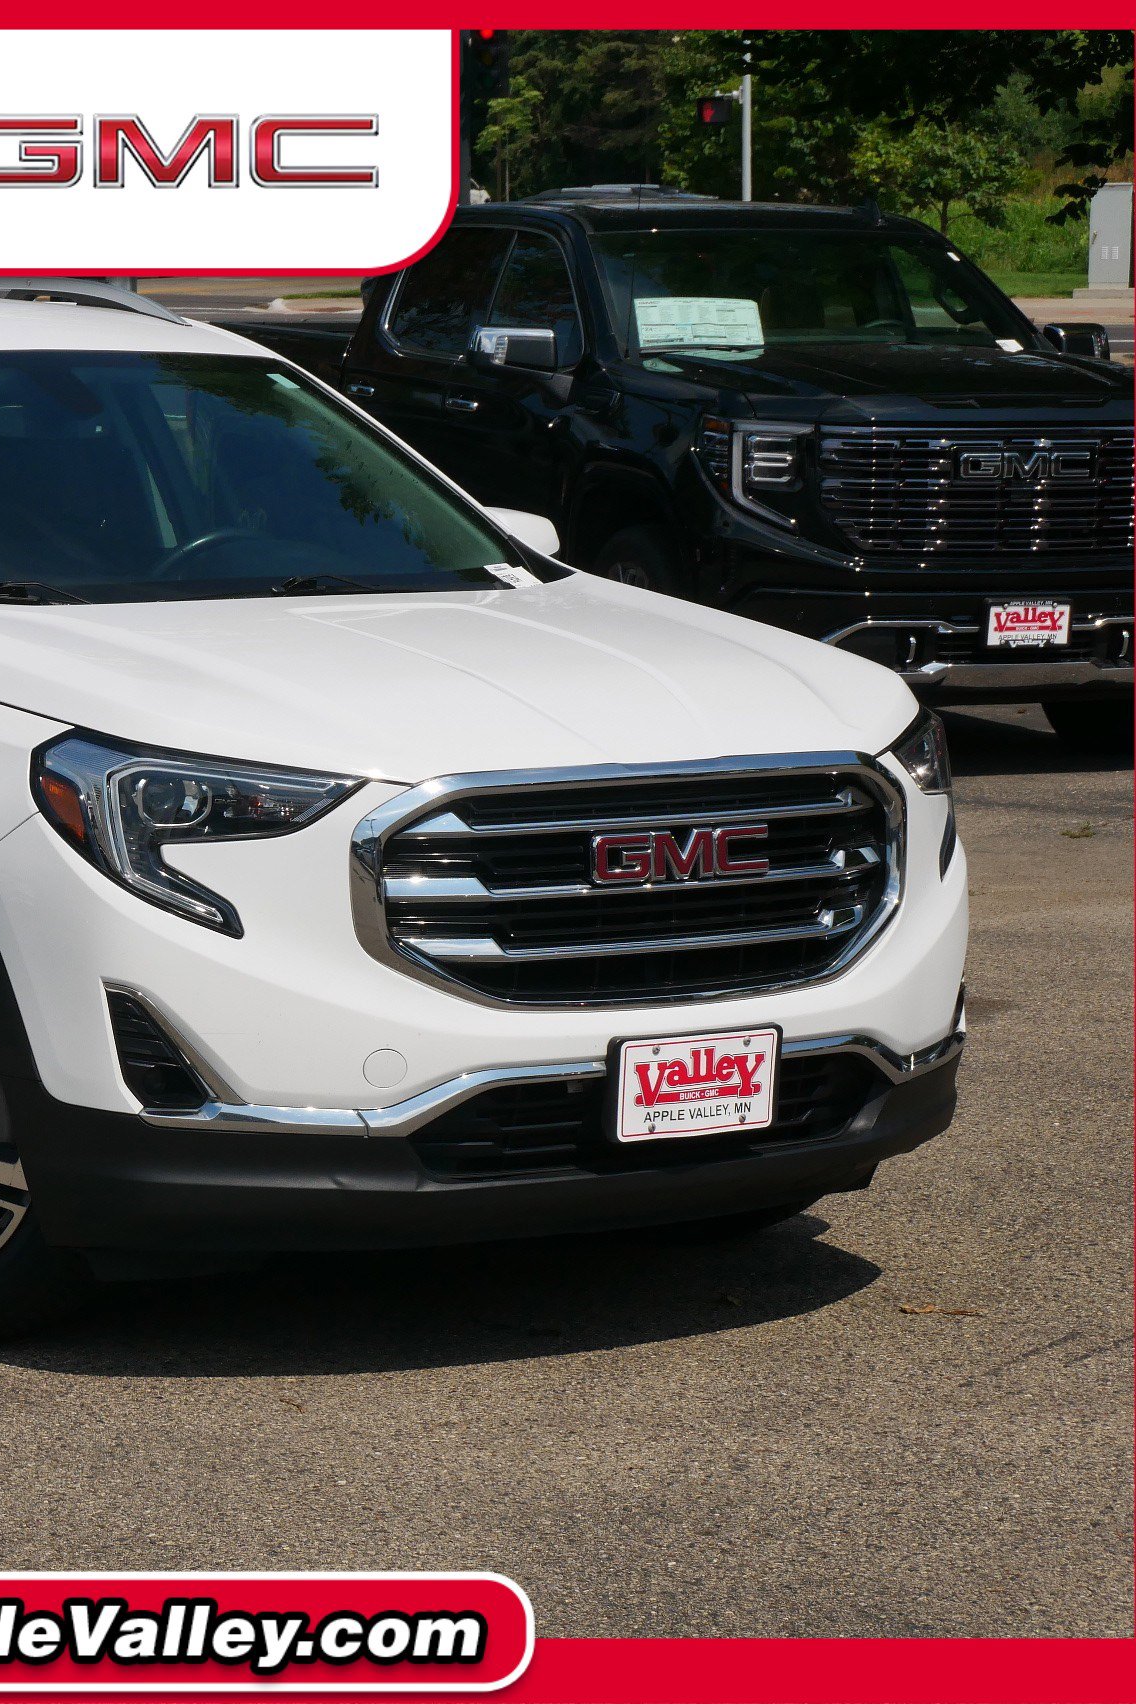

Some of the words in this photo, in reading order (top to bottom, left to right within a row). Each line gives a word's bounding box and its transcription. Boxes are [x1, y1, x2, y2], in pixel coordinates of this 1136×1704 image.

[960, 452, 1091, 478] GMC
[590, 824, 770, 885] GMC
[679, 1091, 701, 1101] BUICK
[704, 1089, 719, 1097] GMC
[644, 1109, 685, 1123] APPLE
[689, 1104, 731, 1120] VALLEY,
[734, 1101, 752, 1114] MN
